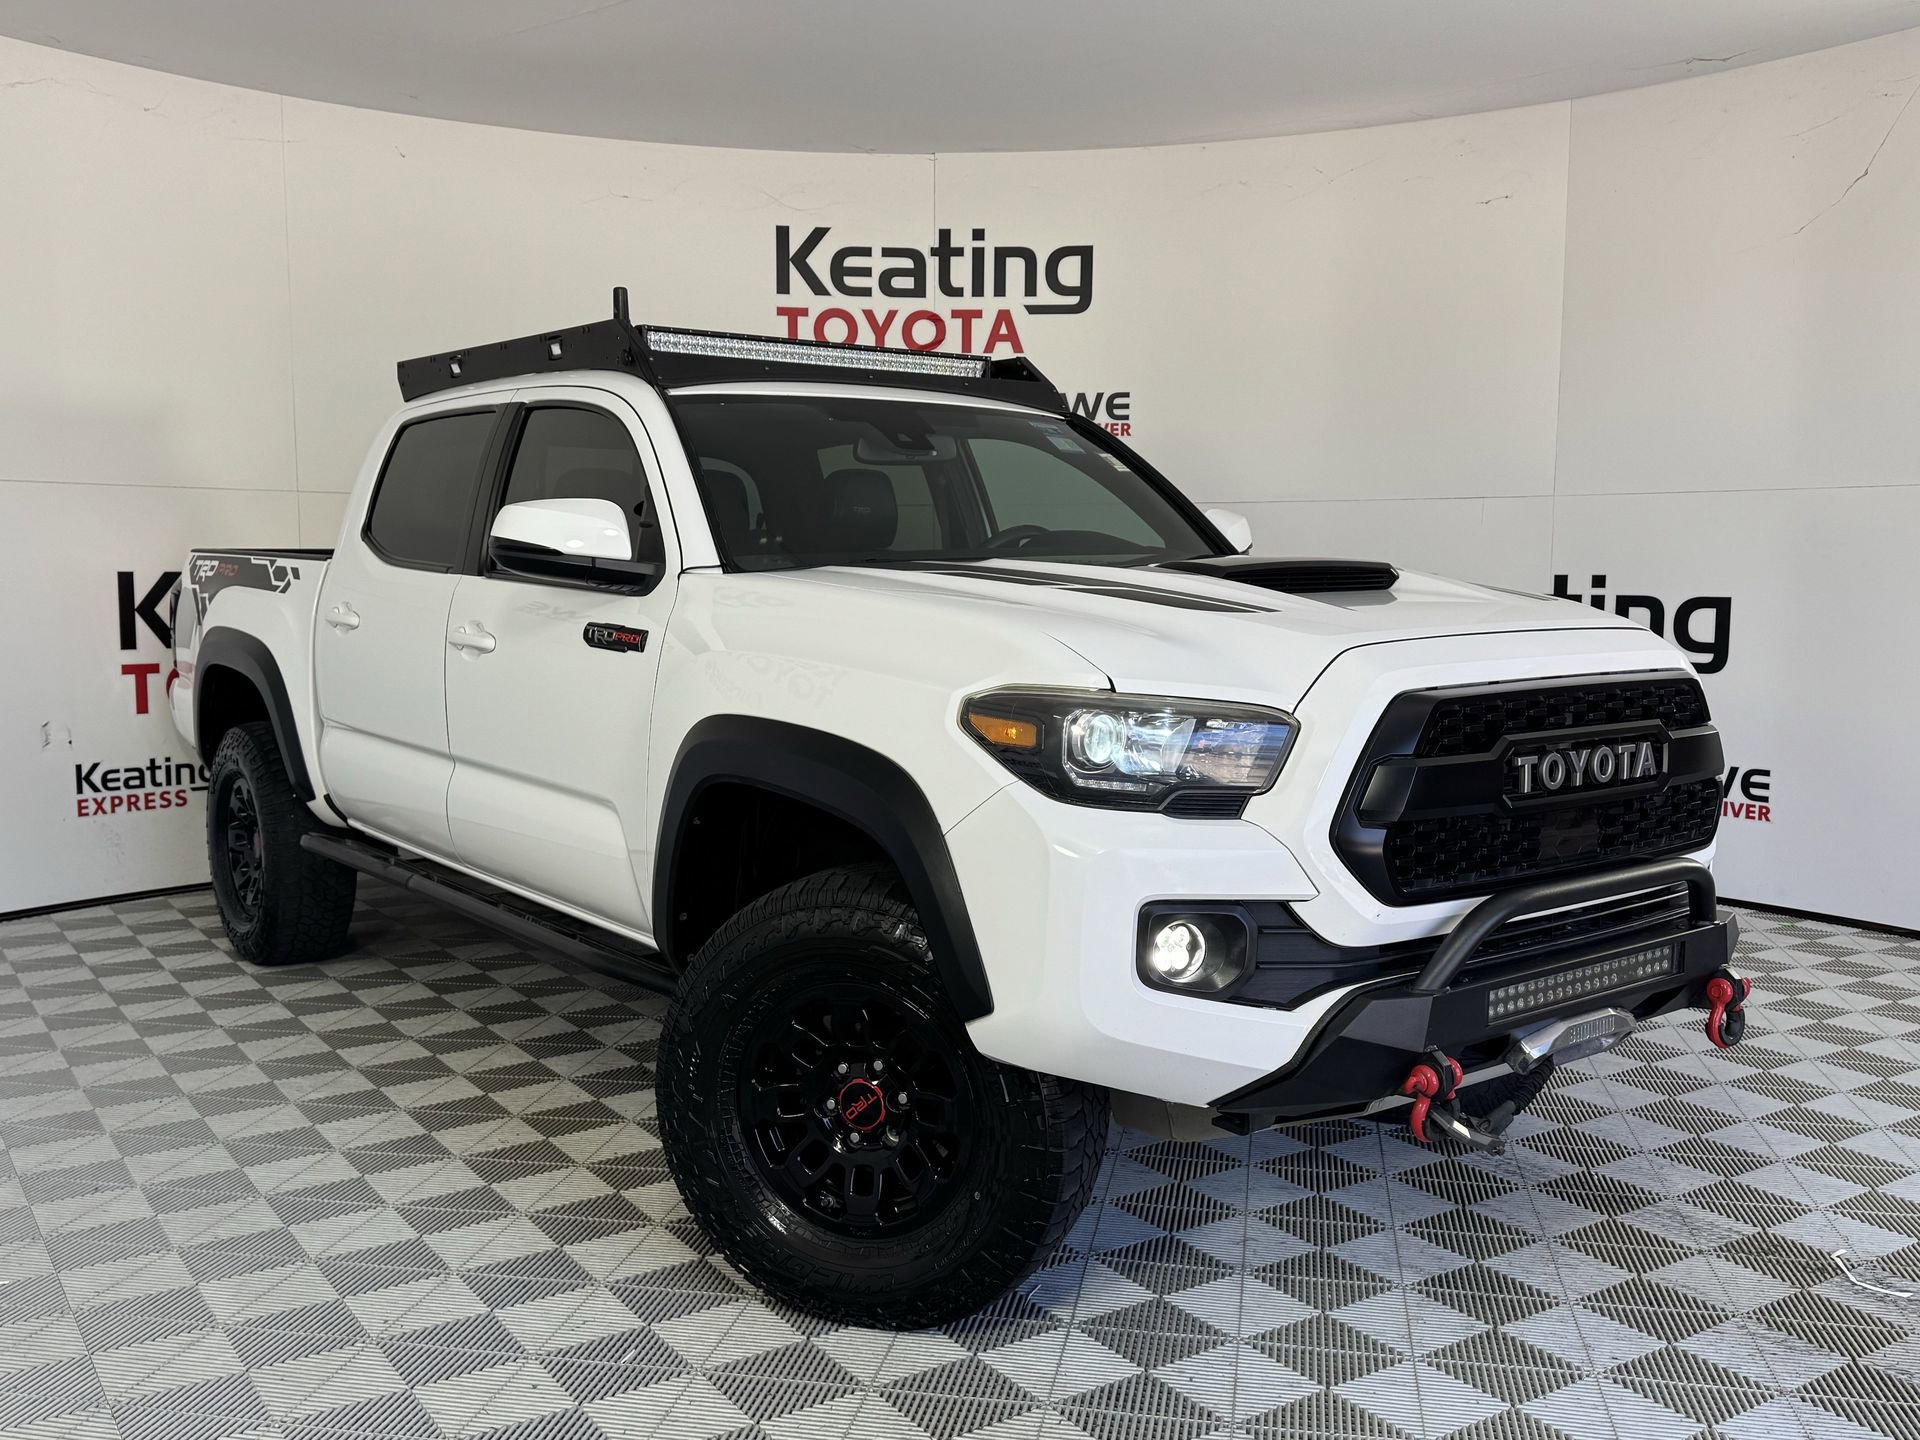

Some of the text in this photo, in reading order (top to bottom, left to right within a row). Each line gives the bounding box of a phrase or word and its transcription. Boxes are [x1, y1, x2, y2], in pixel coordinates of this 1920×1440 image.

[776, 225, 1094, 314] Keating
[776, 306, 1025, 354] TOYOTA
[194, 559, 220, 582] TRD
[586, 626, 641, 645] TRD PRO
[1513, 740, 1658, 794] TOYOTA
[77, 789, 189, 817] EXPRESS
[845, 1093, 878, 1120] TRD
